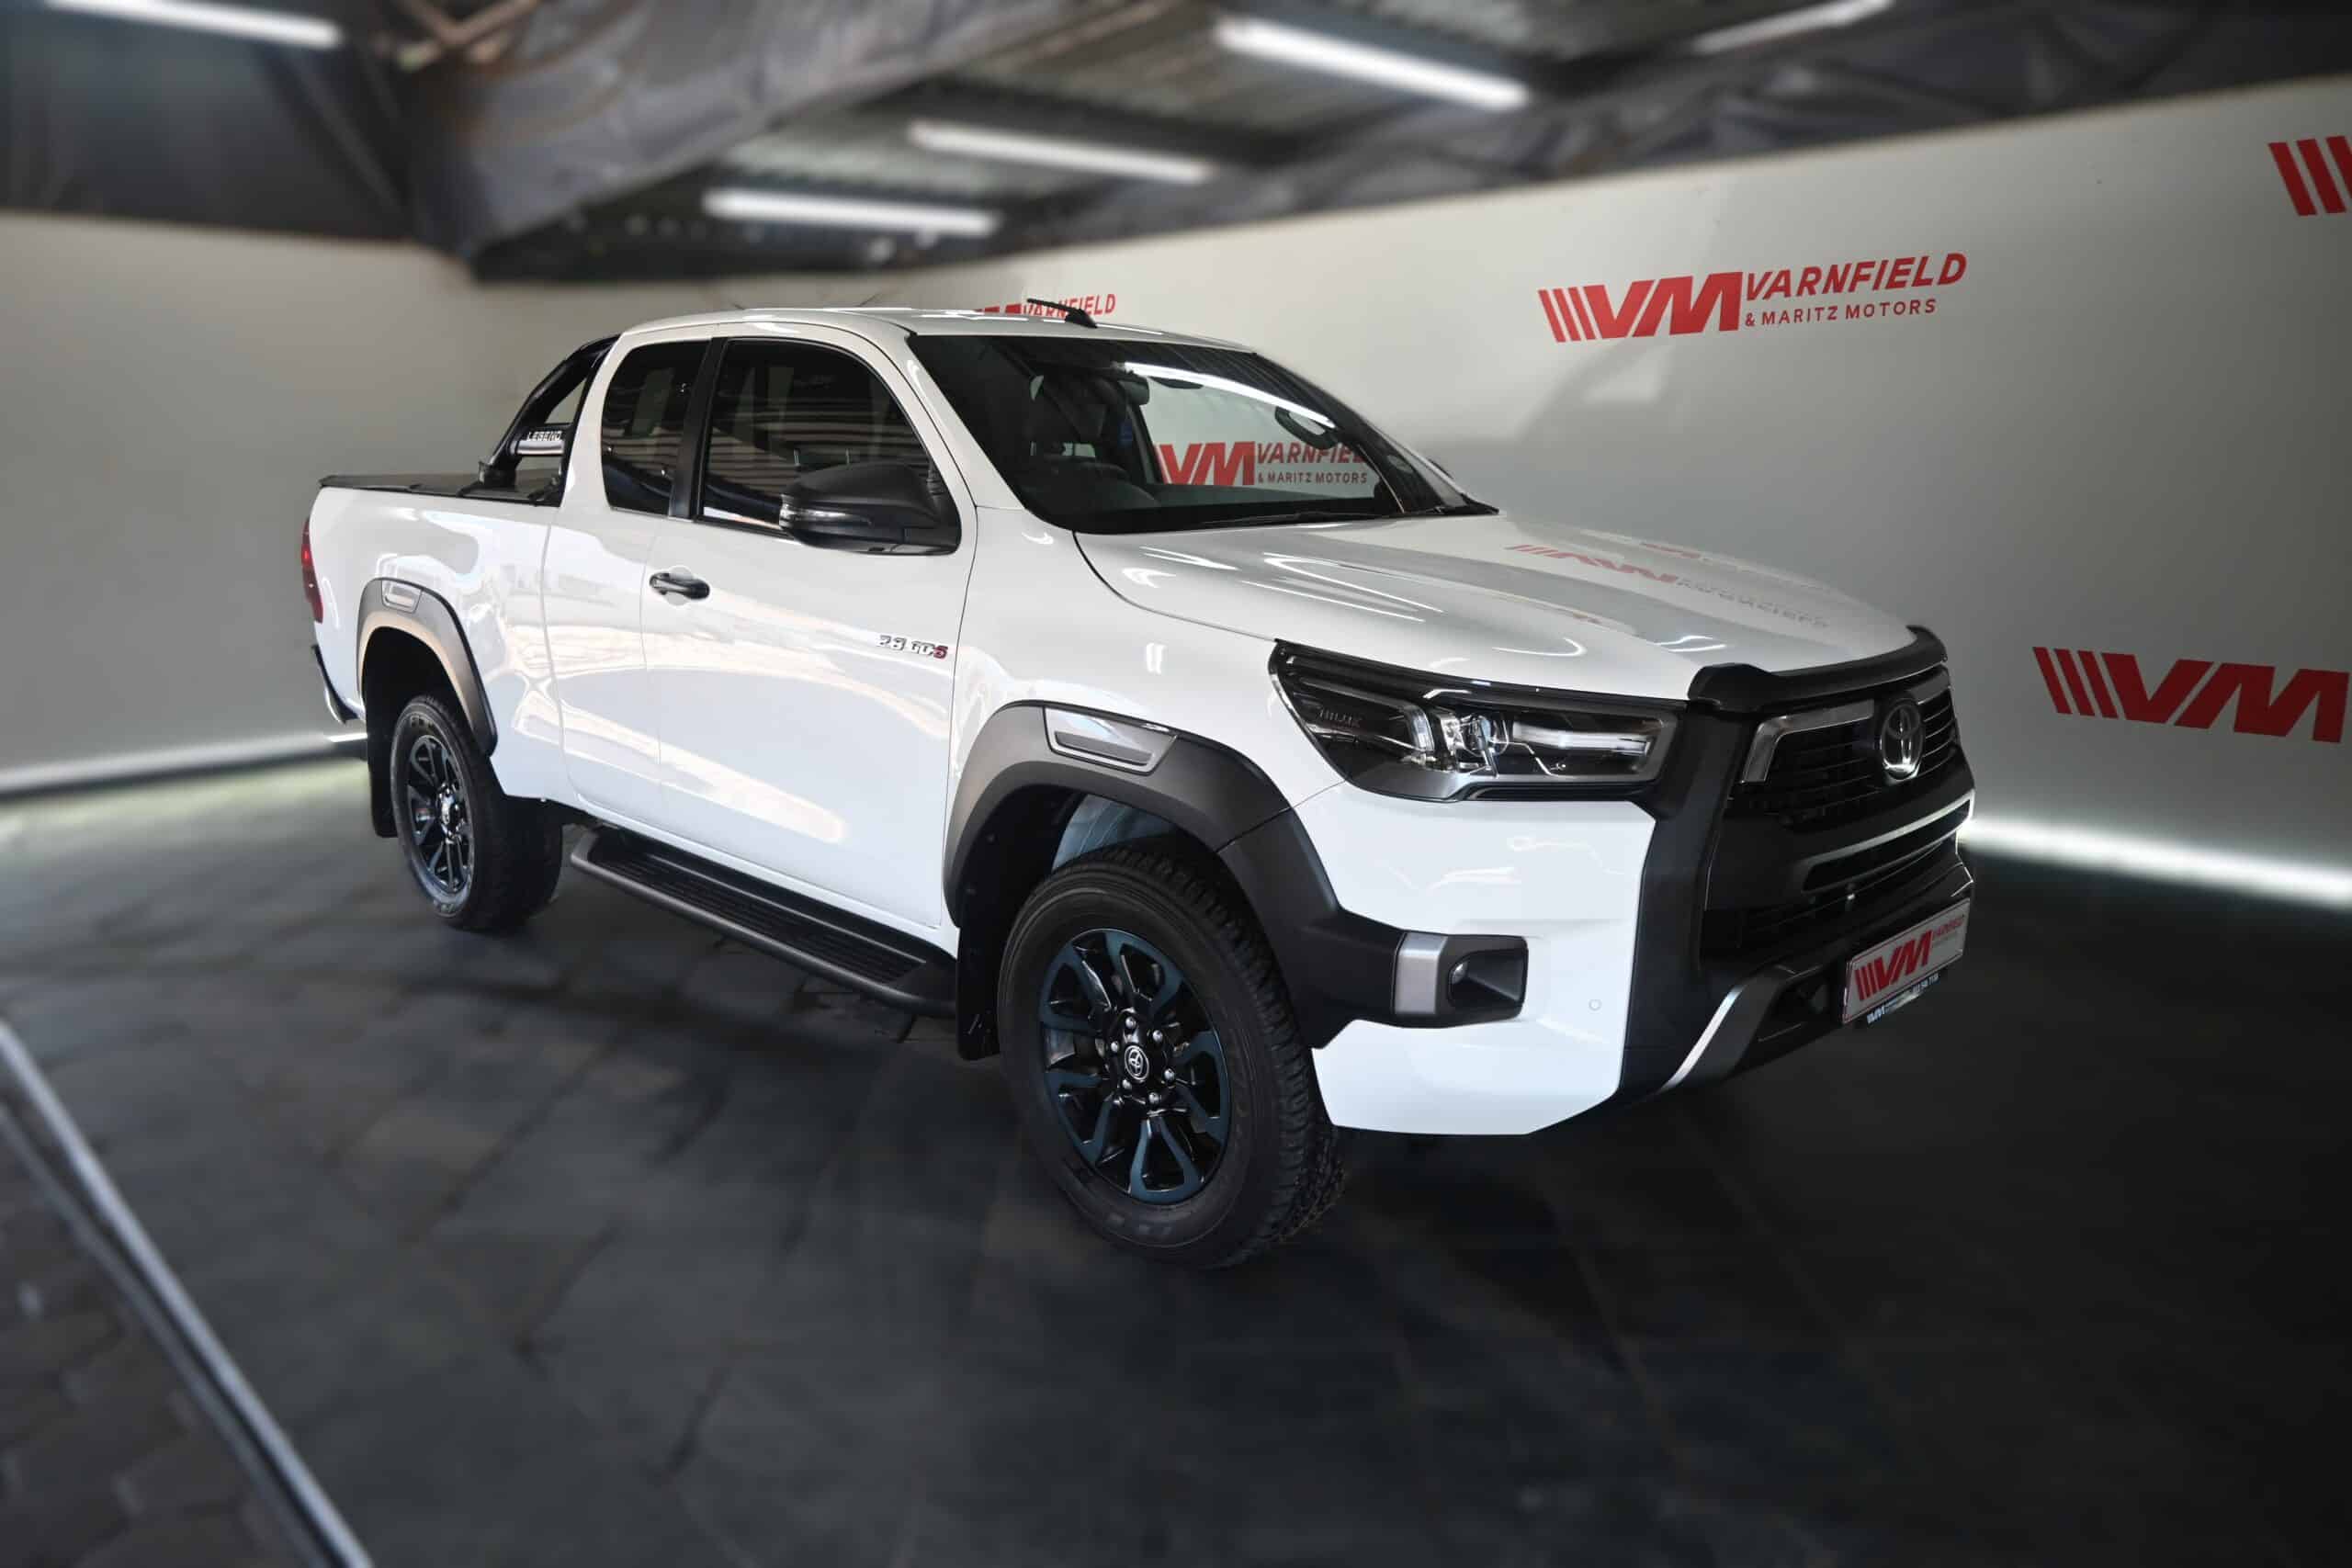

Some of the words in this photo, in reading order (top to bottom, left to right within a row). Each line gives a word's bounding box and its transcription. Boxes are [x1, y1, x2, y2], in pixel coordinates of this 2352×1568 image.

[1582, 270, 1744, 339] VM
[1746, 252, 1968, 301] VARNFIELD
[1745, 312, 1756, 327] &
[1761, 305, 1838, 325] MARITZ
[1845, 298, 1938, 320] MOTORS
[1160, 441, 1255, 486] VM
[1267, 470, 1313, 484] MARITZ
[1314, 471, 1368, 484] MOTORS
[2101, 652, 2351, 744] VM
[1873, 931, 1933, 991] VM
